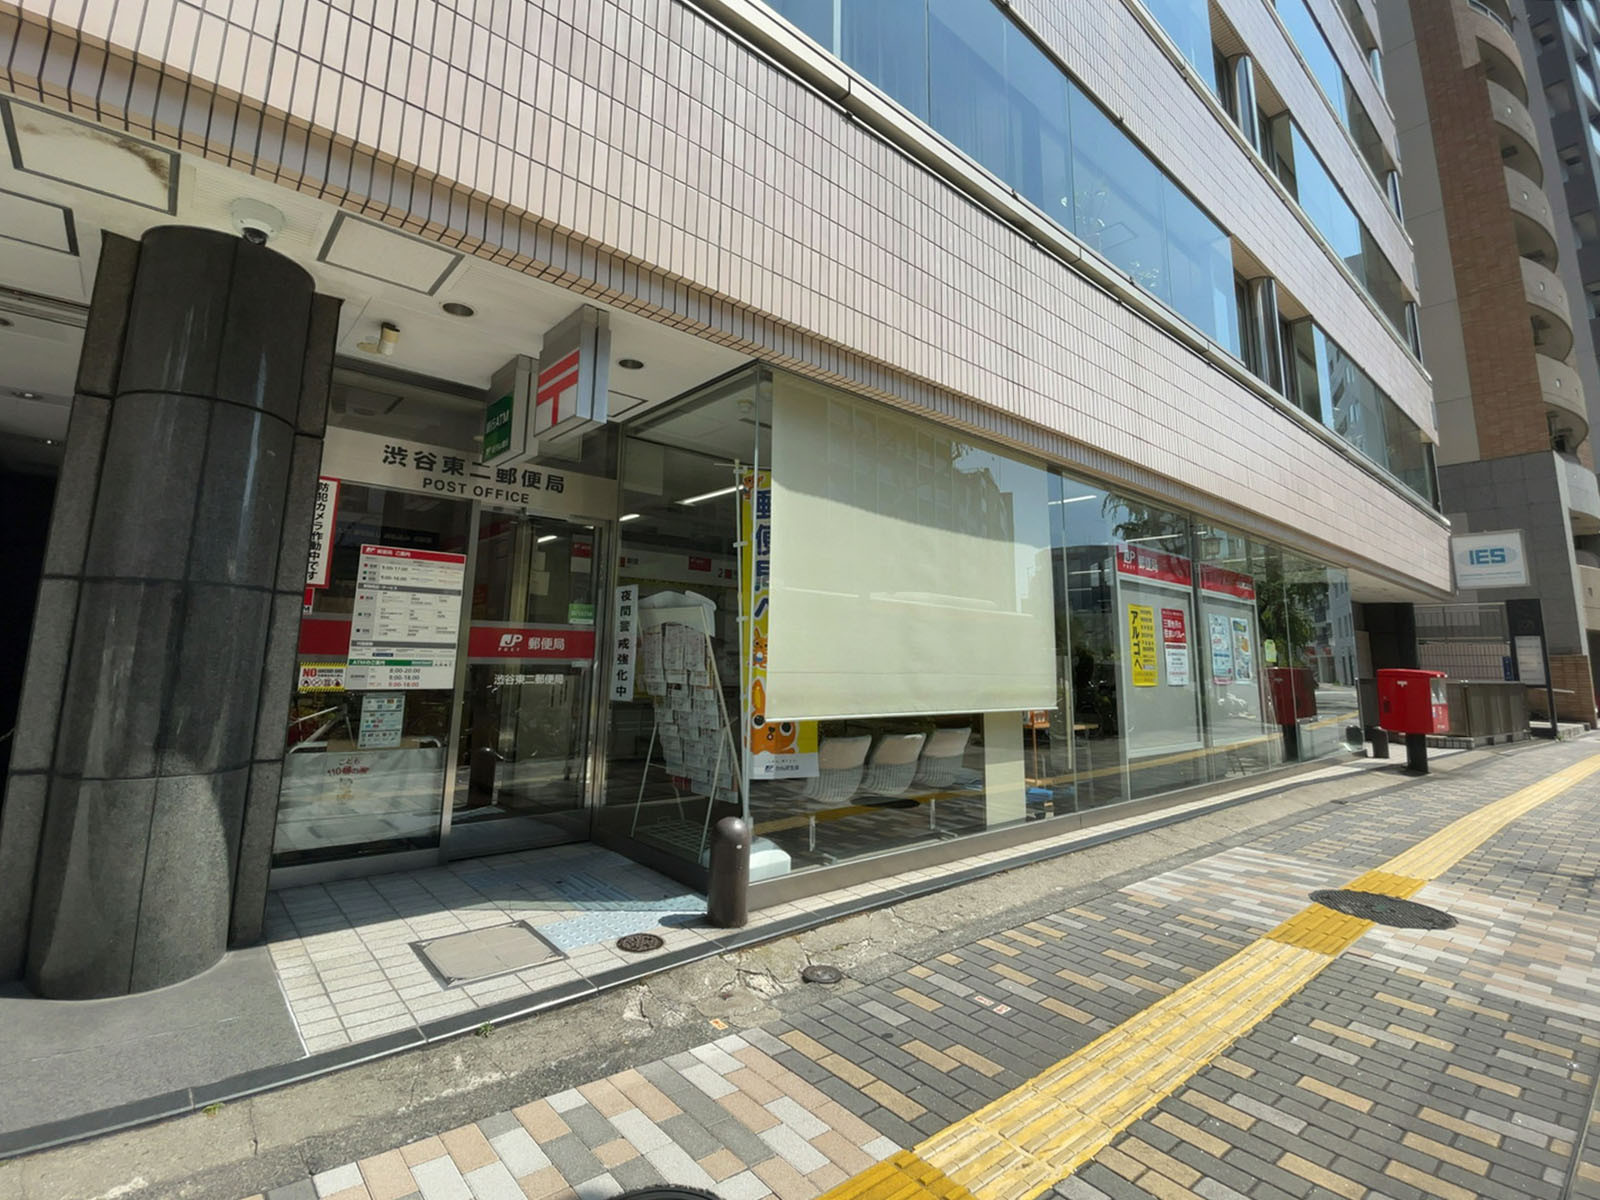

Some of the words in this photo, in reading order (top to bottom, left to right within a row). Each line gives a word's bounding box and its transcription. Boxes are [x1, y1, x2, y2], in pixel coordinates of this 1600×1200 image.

[382, 444, 565, 494] 渋谷東二郵便局
[422, 477, 467, 495] POST
[472, 485, 530, 504] OFFICE
[308, 482, 330, 581] 防犯カメラ作動中です
[1468, 547, 1506, 565] IES
[527, 637, 565, 651] 郵便局
[615, 590, 633, 697] 夜間警戒強化中
[302, 668, 317, 677] NO
[493, 673, 564, 685] 渋谷東二郵便局
